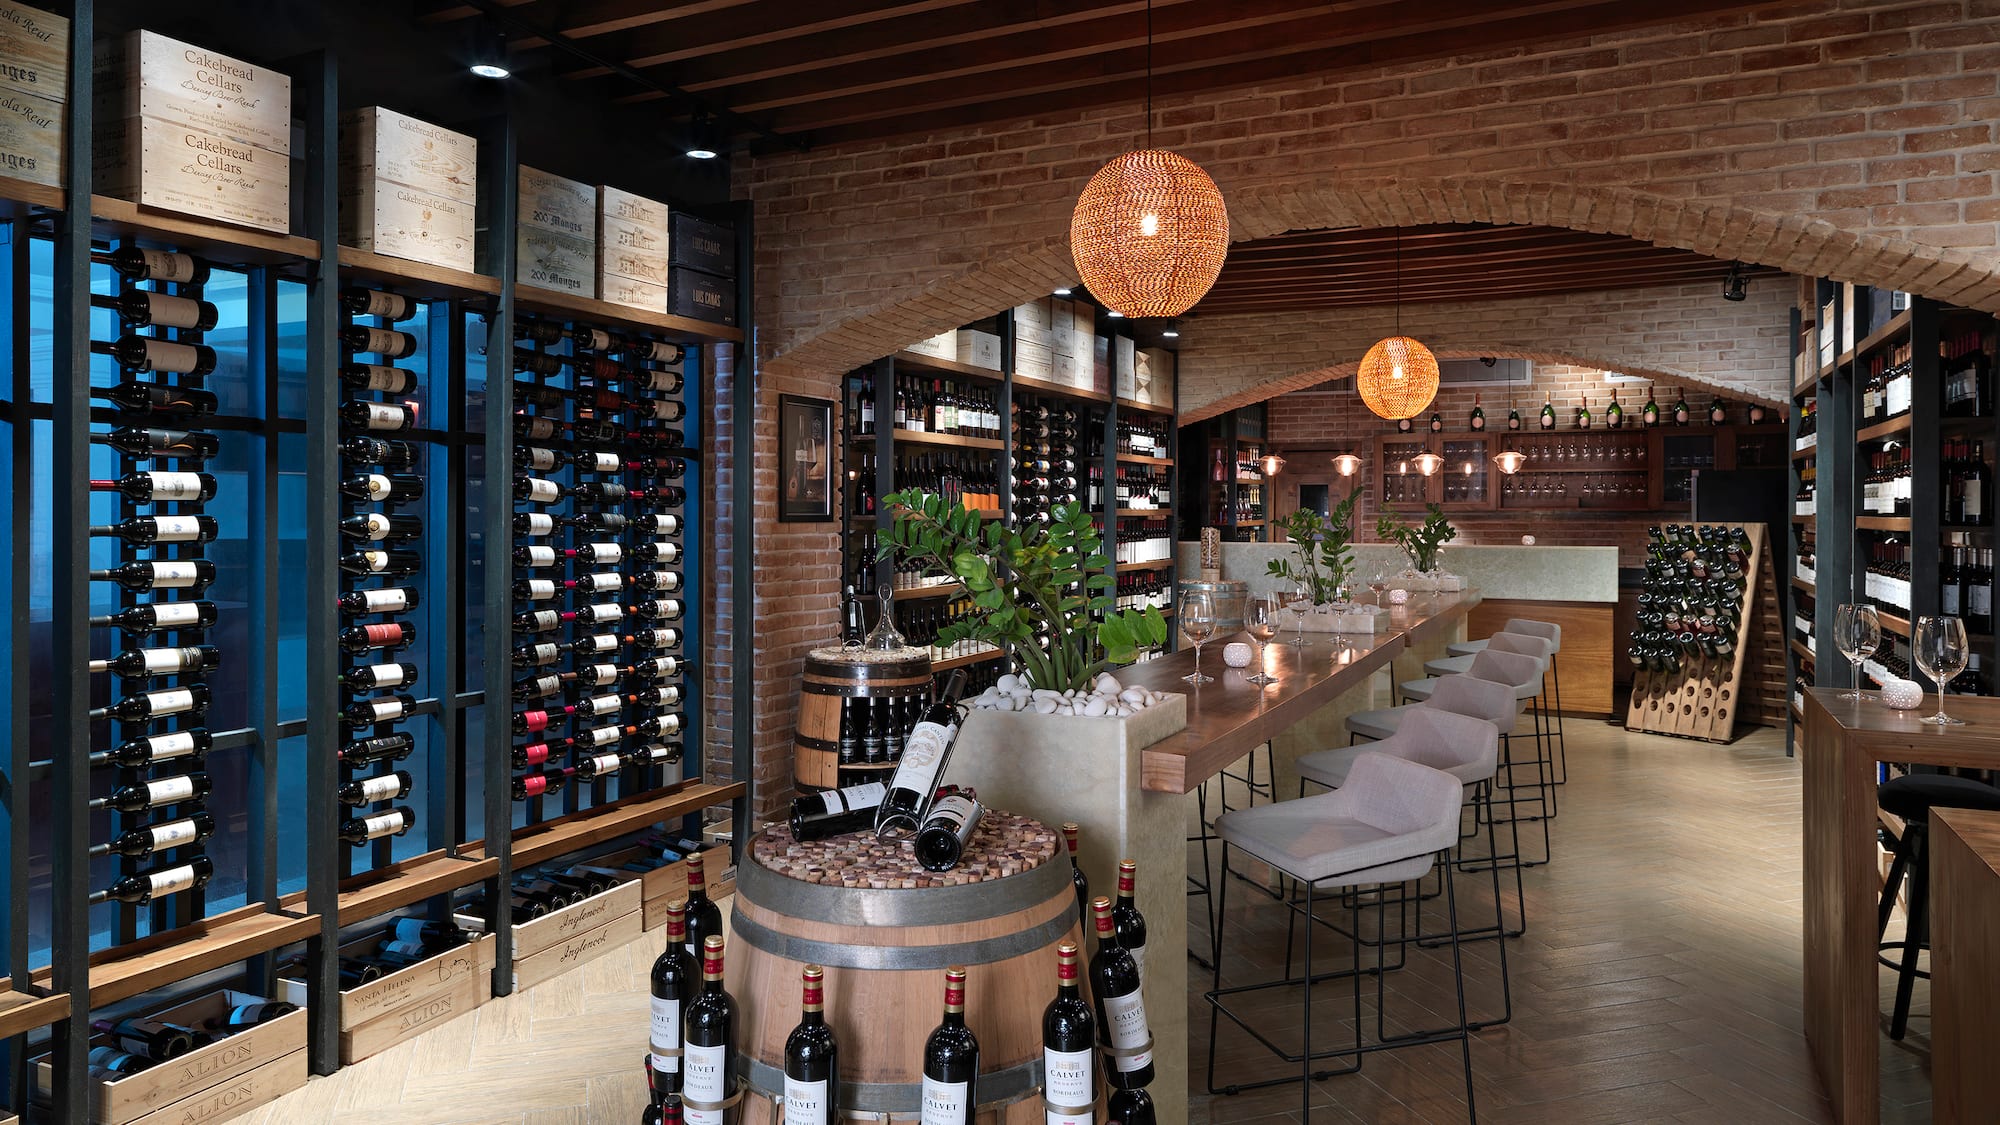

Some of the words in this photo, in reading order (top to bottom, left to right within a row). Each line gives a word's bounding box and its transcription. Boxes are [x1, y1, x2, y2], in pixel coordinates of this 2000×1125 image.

[0, 8, 18, 24] ola
[23, 19, 54, 43] Real
[184, 50, 254, 82] Cakebread
[196, 70, 242, 93] Cellars
[0, 97, 19, 112] ola
[22, 106, 53, 129] Real
[398, 119, 434, 138] Cakebread
[434, 130, 458, 146] Cellars
[185, 134, 253, 163] Cakebread
[196, 153, 242, 175] Cellars
[397, 190, 433, 208] Cakebread
[433, 201, 456, 214] Cellars
[532, 210, 549, 222] 200
[550, 215, 583, 232] Monges
[530, 268, 547, 281] 200
[548, 272, 581, 289] Monges
[559, 899, 608, 931] Inglenook
[559, 929, 608, 963] Inglenook
[354, 991, 381, 1006] SANTA
[383, 975, 416, 994] HELENA
[399, 996, 452, 1030] ALION
[1114, 1005, 1144, 1022] CALVET
[178, 1042, 252, 1083] ALION
[1050, 1069, 1085, 1079] CALVET
[179, 1082, 253, 1125] ALION
[786, 1096, 817, 1109] CALVET
[924, 1096, 957, 1111] CALVET
